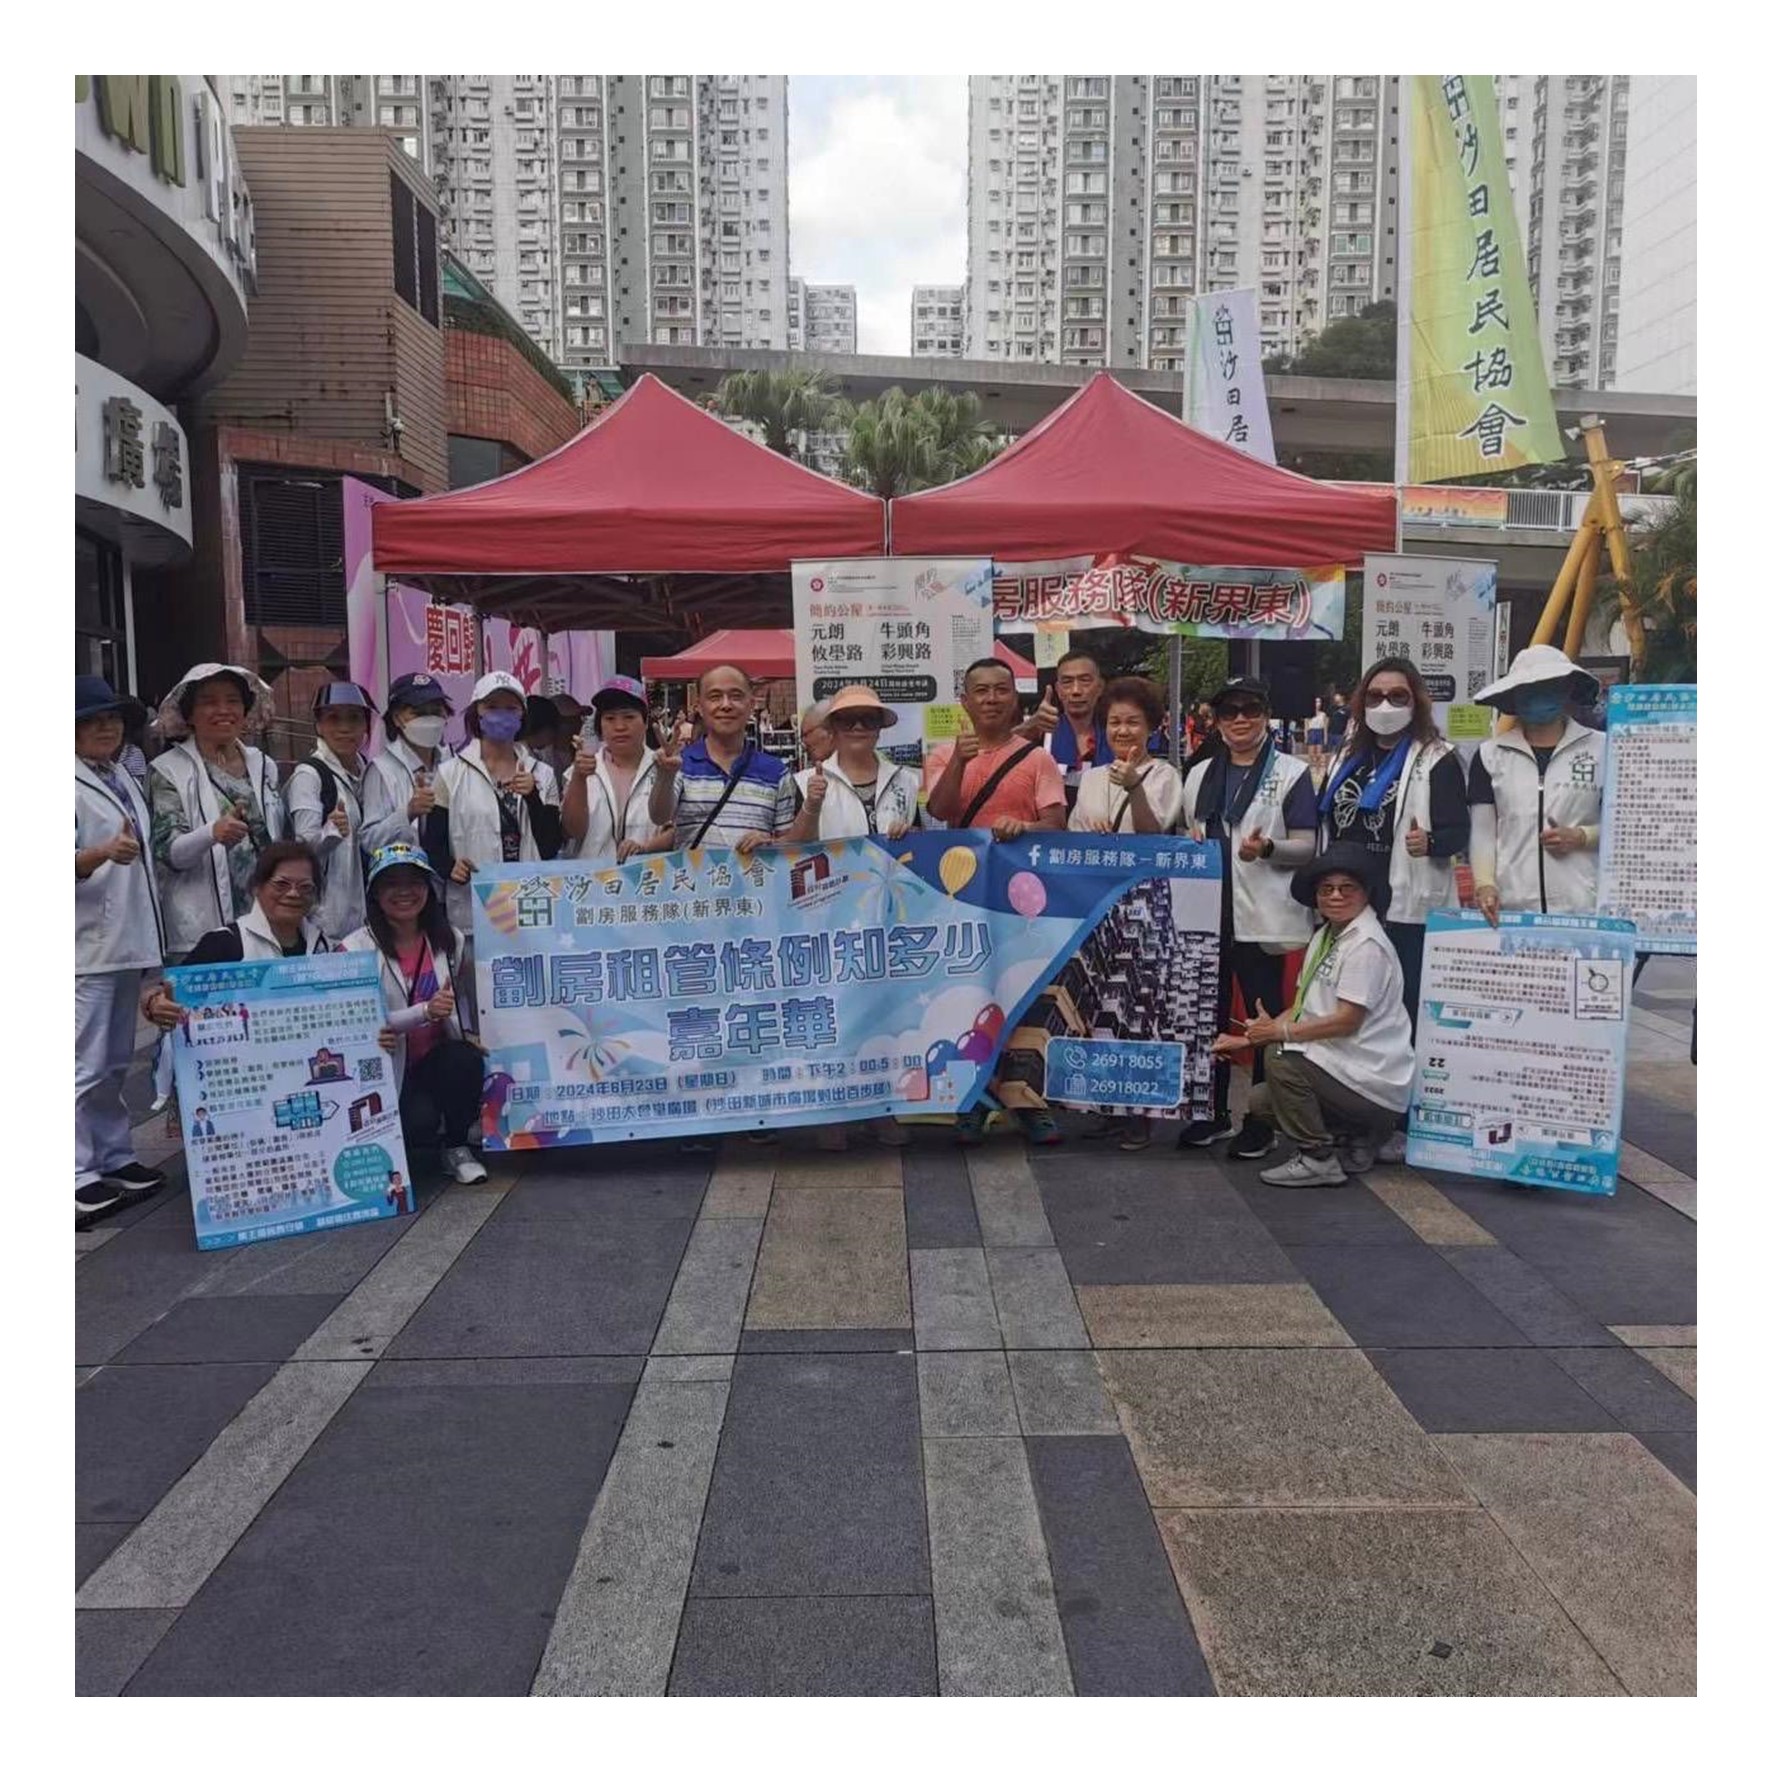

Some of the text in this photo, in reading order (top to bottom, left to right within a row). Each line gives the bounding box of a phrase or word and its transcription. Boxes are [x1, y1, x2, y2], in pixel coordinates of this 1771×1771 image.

[811, 622, 844, 640] 元朗
[880, 621, 930, 639] 牛頭角
[1375, 619, 1399, 637] 元朗
[1421, 621, 1454, 639] 牛頭角
[881, 643, 931, 661] 彩興路
[564, 856, 775, 902] 沙田居民協會
[492, 921, 994, 1009] 劏房租管條例知多少
[667, 996, 837, 1062] 嘉年華
[1428, 1057, 1446, 1068] 22
